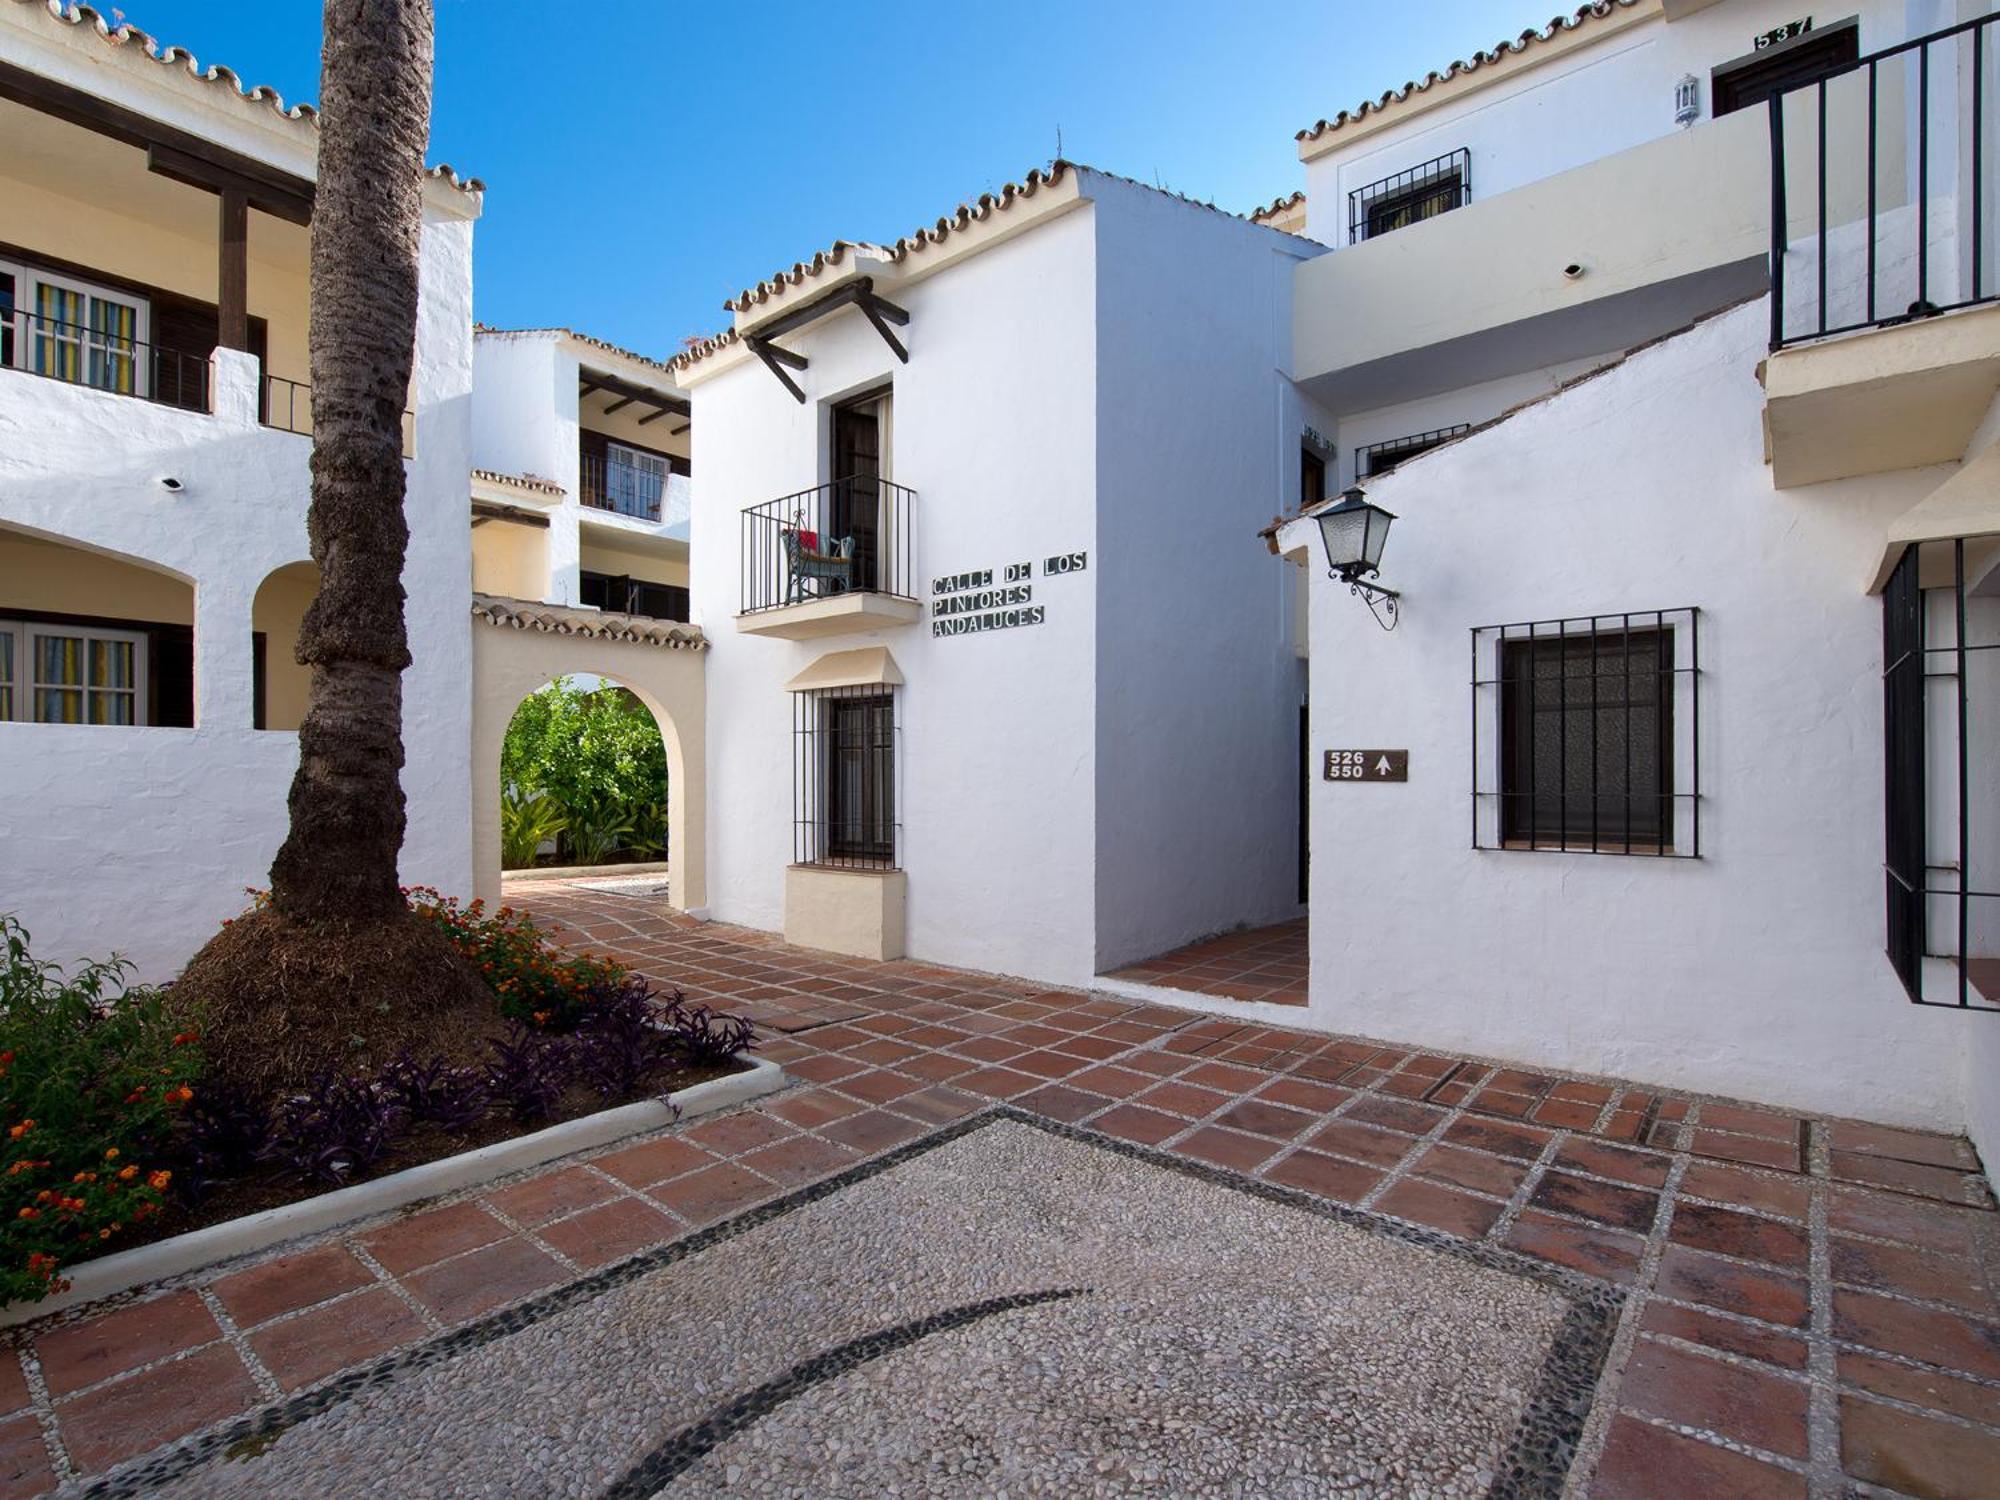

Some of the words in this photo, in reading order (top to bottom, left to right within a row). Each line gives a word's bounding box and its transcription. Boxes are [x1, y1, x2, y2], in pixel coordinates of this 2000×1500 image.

[1757, 16, 1809, 49] 537
[933, 570, 992, 595] CALLE
[1005, 563, 1031, 582] DE
[1045, 551, 1086, 576] LOS
[933, 586, 1030, 616] PINTORES
[933, 606, 1043, 637] ANDALUCES
[1330, 752, 1364, 764] 526
[1330, 765, 1363, 778] 550
